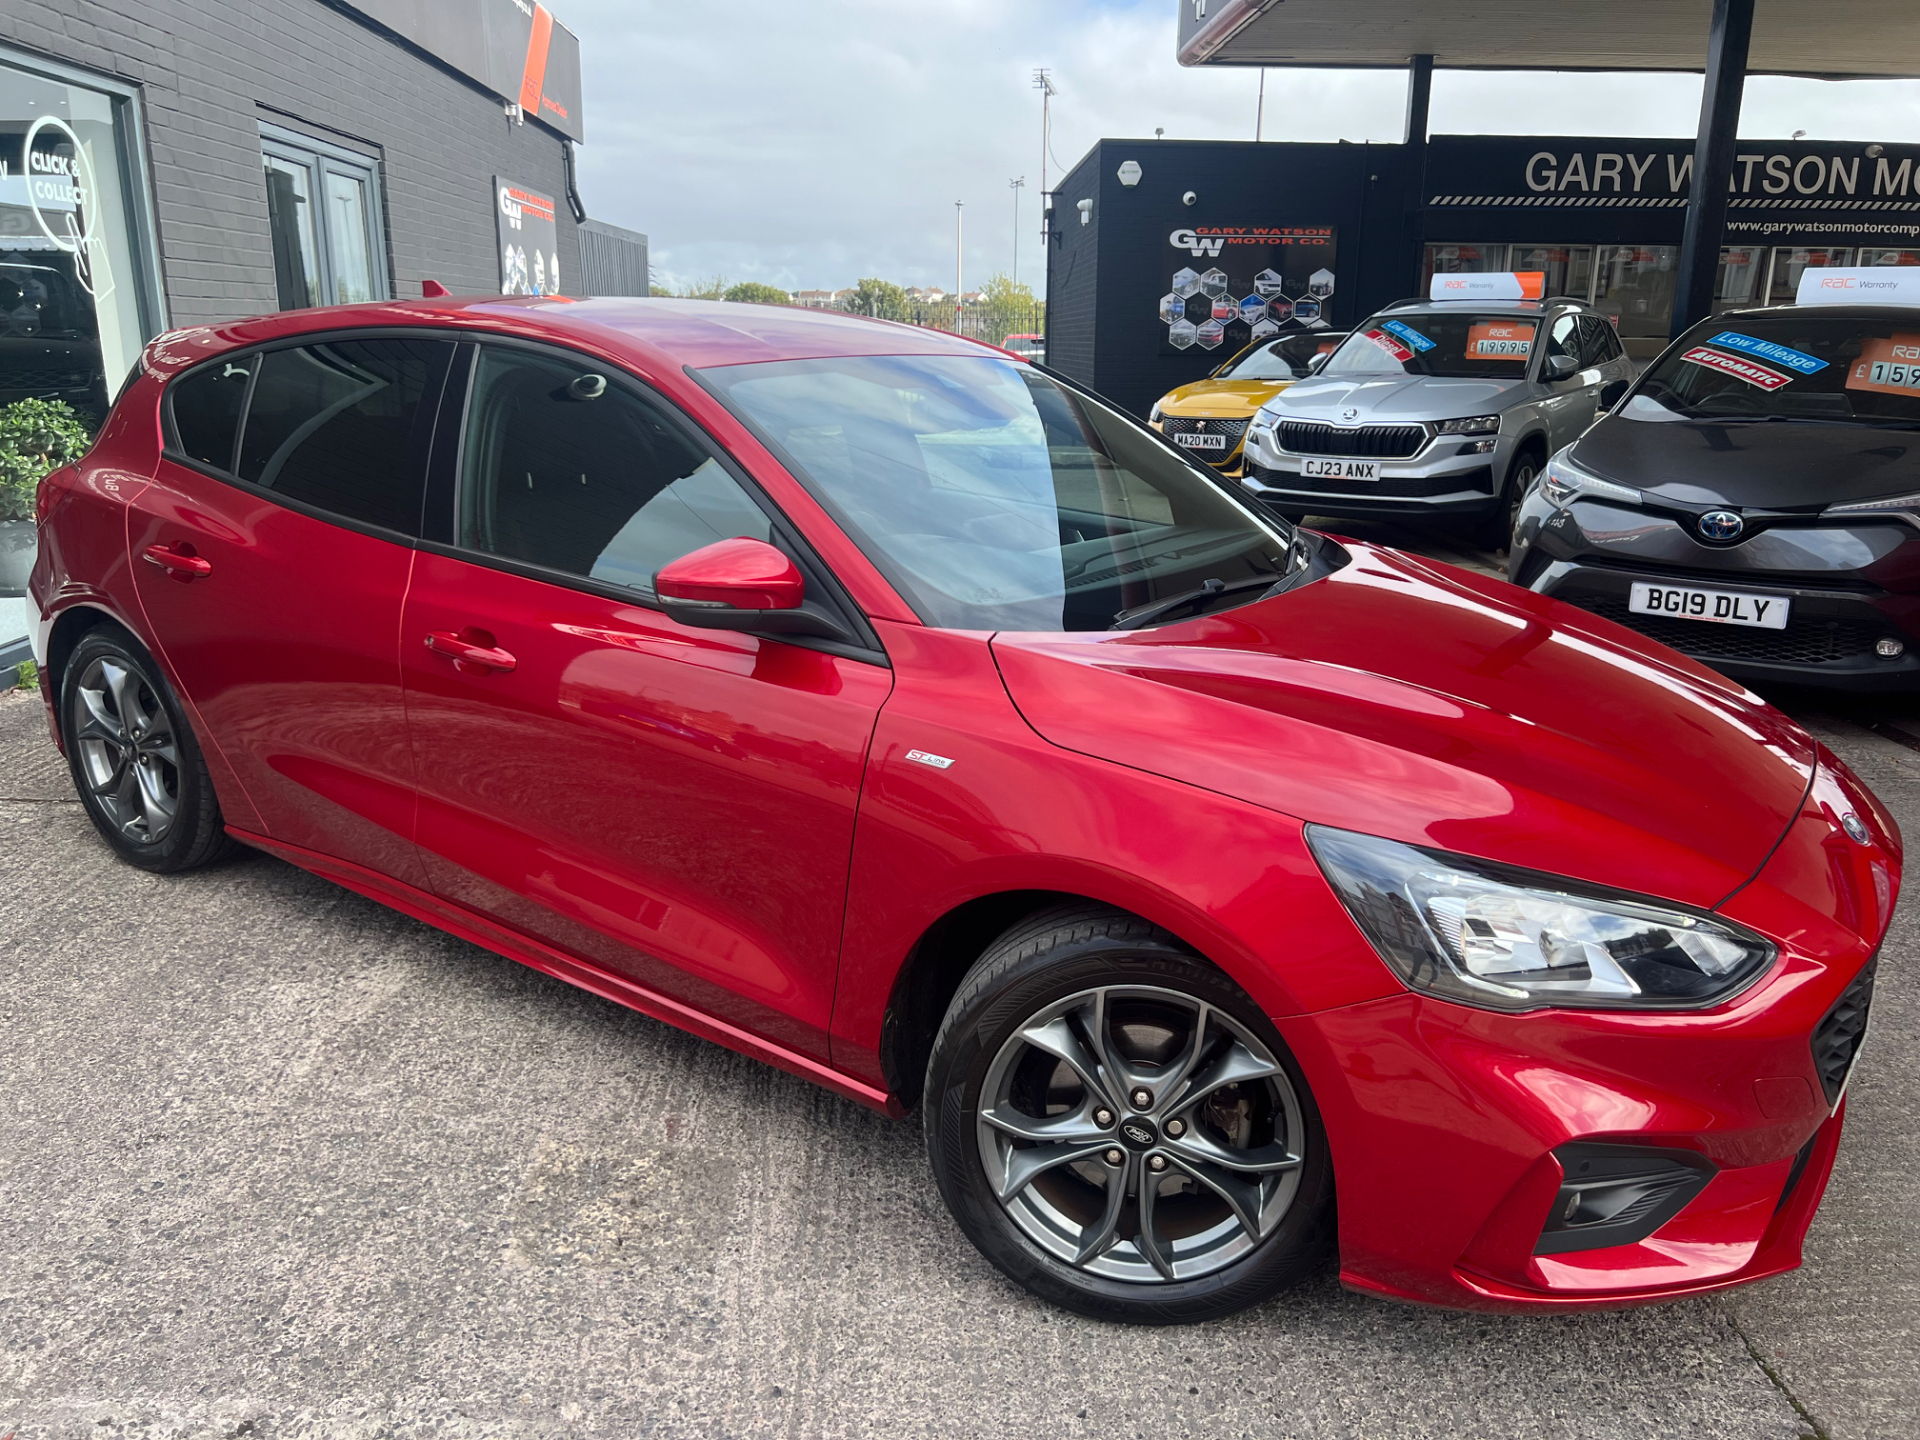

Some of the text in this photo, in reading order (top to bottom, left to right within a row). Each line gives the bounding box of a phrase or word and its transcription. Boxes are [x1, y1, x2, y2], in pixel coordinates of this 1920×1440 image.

[31, 151, 81, 177] CLICK &
[1525, 152, 1920, 196] GARY WTSON M
[35, 180, 88, 205] COLLECT
[509, 187, 554, 210] GARY WATSON
[499, 187, 522, 231] GW
[521, 204, 544, 218] MOTOR
[1169, 229, 1225, 257] GW
[1196, 227, 1331, 236] GARY WATSON
[1227, 237, 1330, 246] MOTOR CO.
[1469, 282, 1494, 290] Warranty
[1859, 280, 1898, 290] Warranty
[1374, 334, 1403, 355] Diesel
[1387, 320, 1429, 349] Low Mileage
[1479, 342, 1529, 354] 19995
[1717, 332, 1817, 369] Low Mileage
[1689, 350, 1781, 386] AUTOMATIC
[1177, 435, 1222, 447] MA20 MXN
[1306, 460, 1375, 478] CJ23 ANX
[1646, 588, 1770, 622] BG19 DLY
